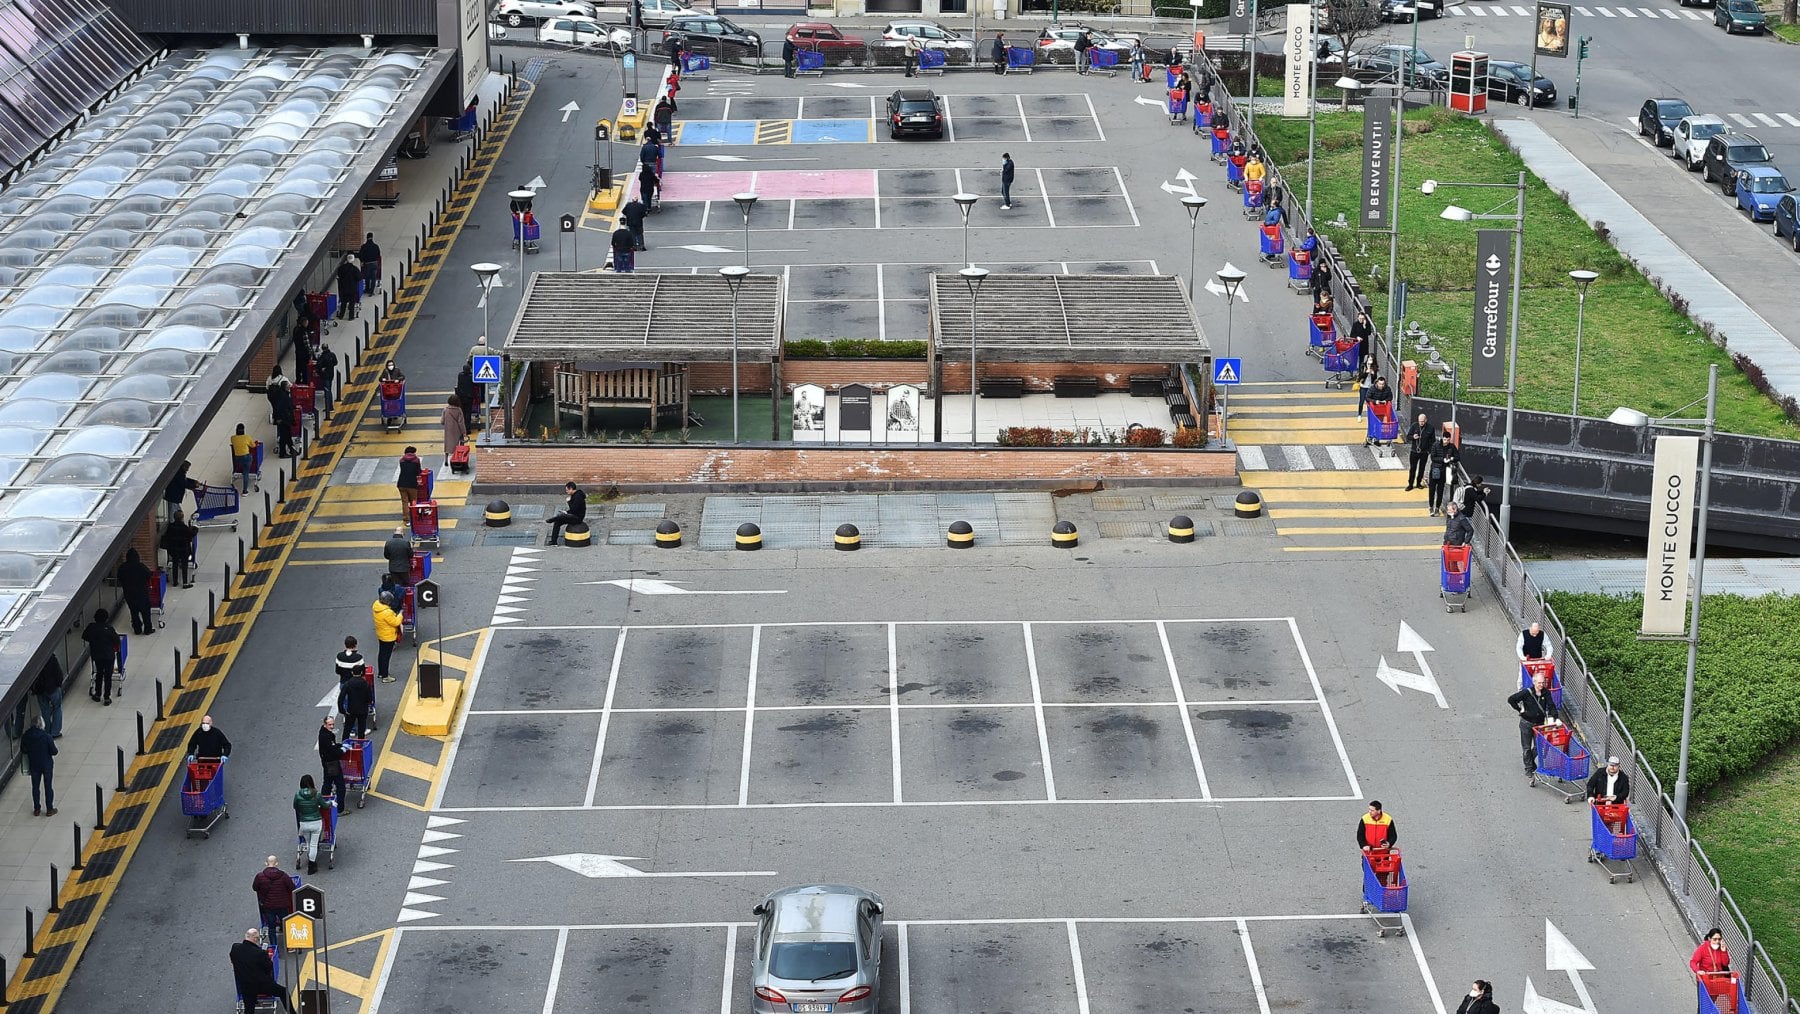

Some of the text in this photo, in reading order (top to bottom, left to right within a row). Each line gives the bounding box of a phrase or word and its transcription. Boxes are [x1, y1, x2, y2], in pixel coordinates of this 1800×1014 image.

[1292, 26, 1303, 99] MONTE CUCCO
[598, 130, 605, 138] E
[1370, 121, 1383, 206] BENVENUTI!
[563, 221, 572, 229] D
[1481, 281, 1500, 358] Carrefour
[1660, 474, 1682, 601] MONTE CUCCO
[422, 590, 433, 602] C
[302, 898, 316, 912] B
